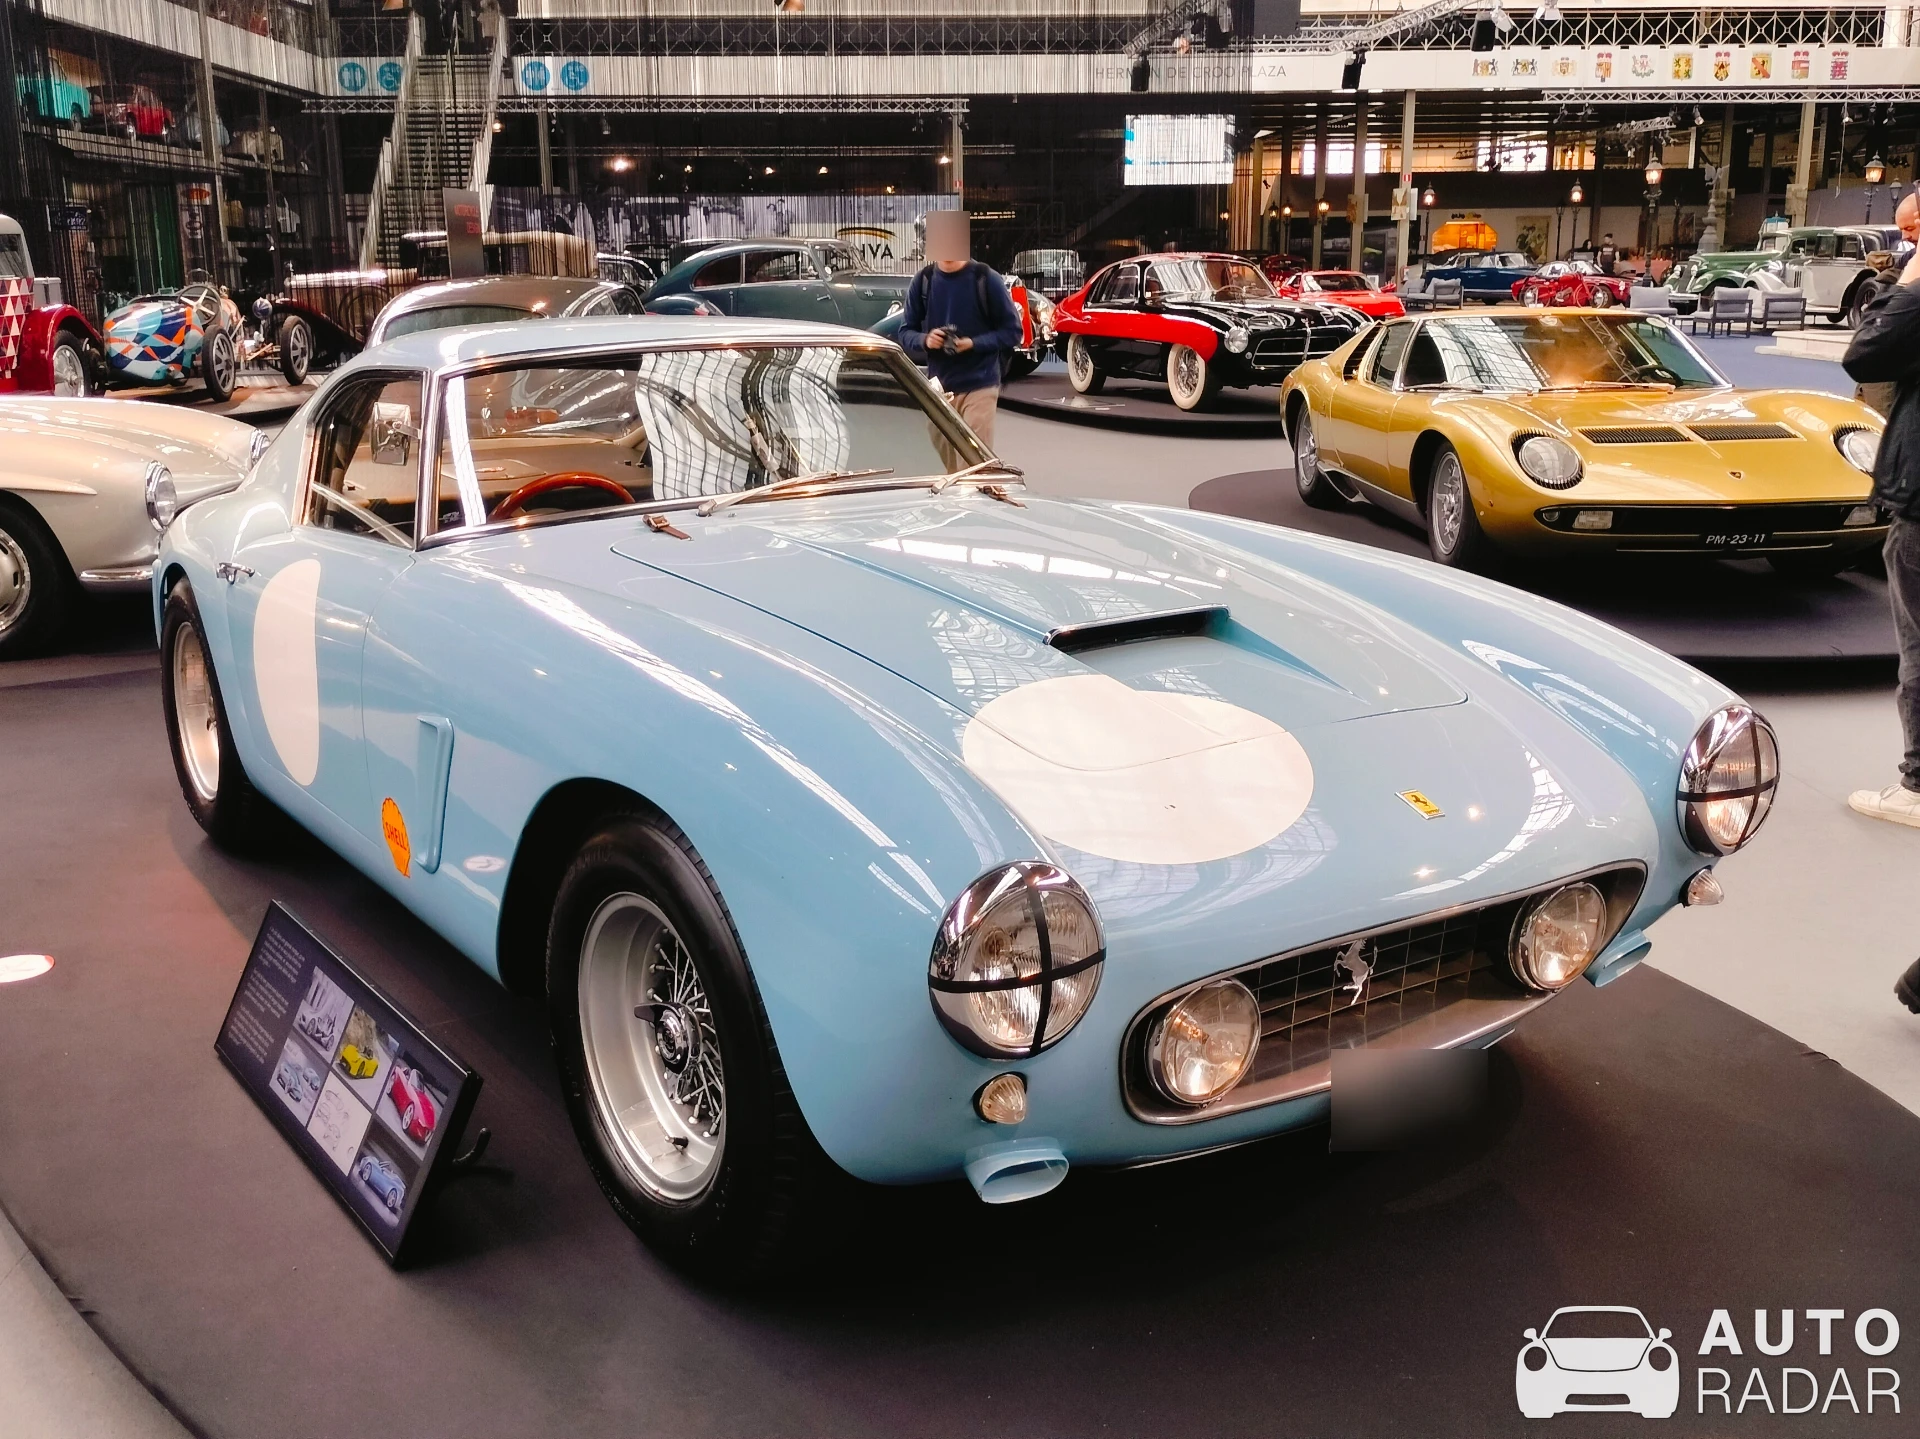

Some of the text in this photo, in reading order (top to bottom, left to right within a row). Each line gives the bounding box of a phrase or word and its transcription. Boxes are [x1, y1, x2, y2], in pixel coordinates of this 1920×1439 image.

[1095, 65, 1287, 79] HERMN DE CROO PLAZA
[1705, 533, 1766, 545] PM-23-11
